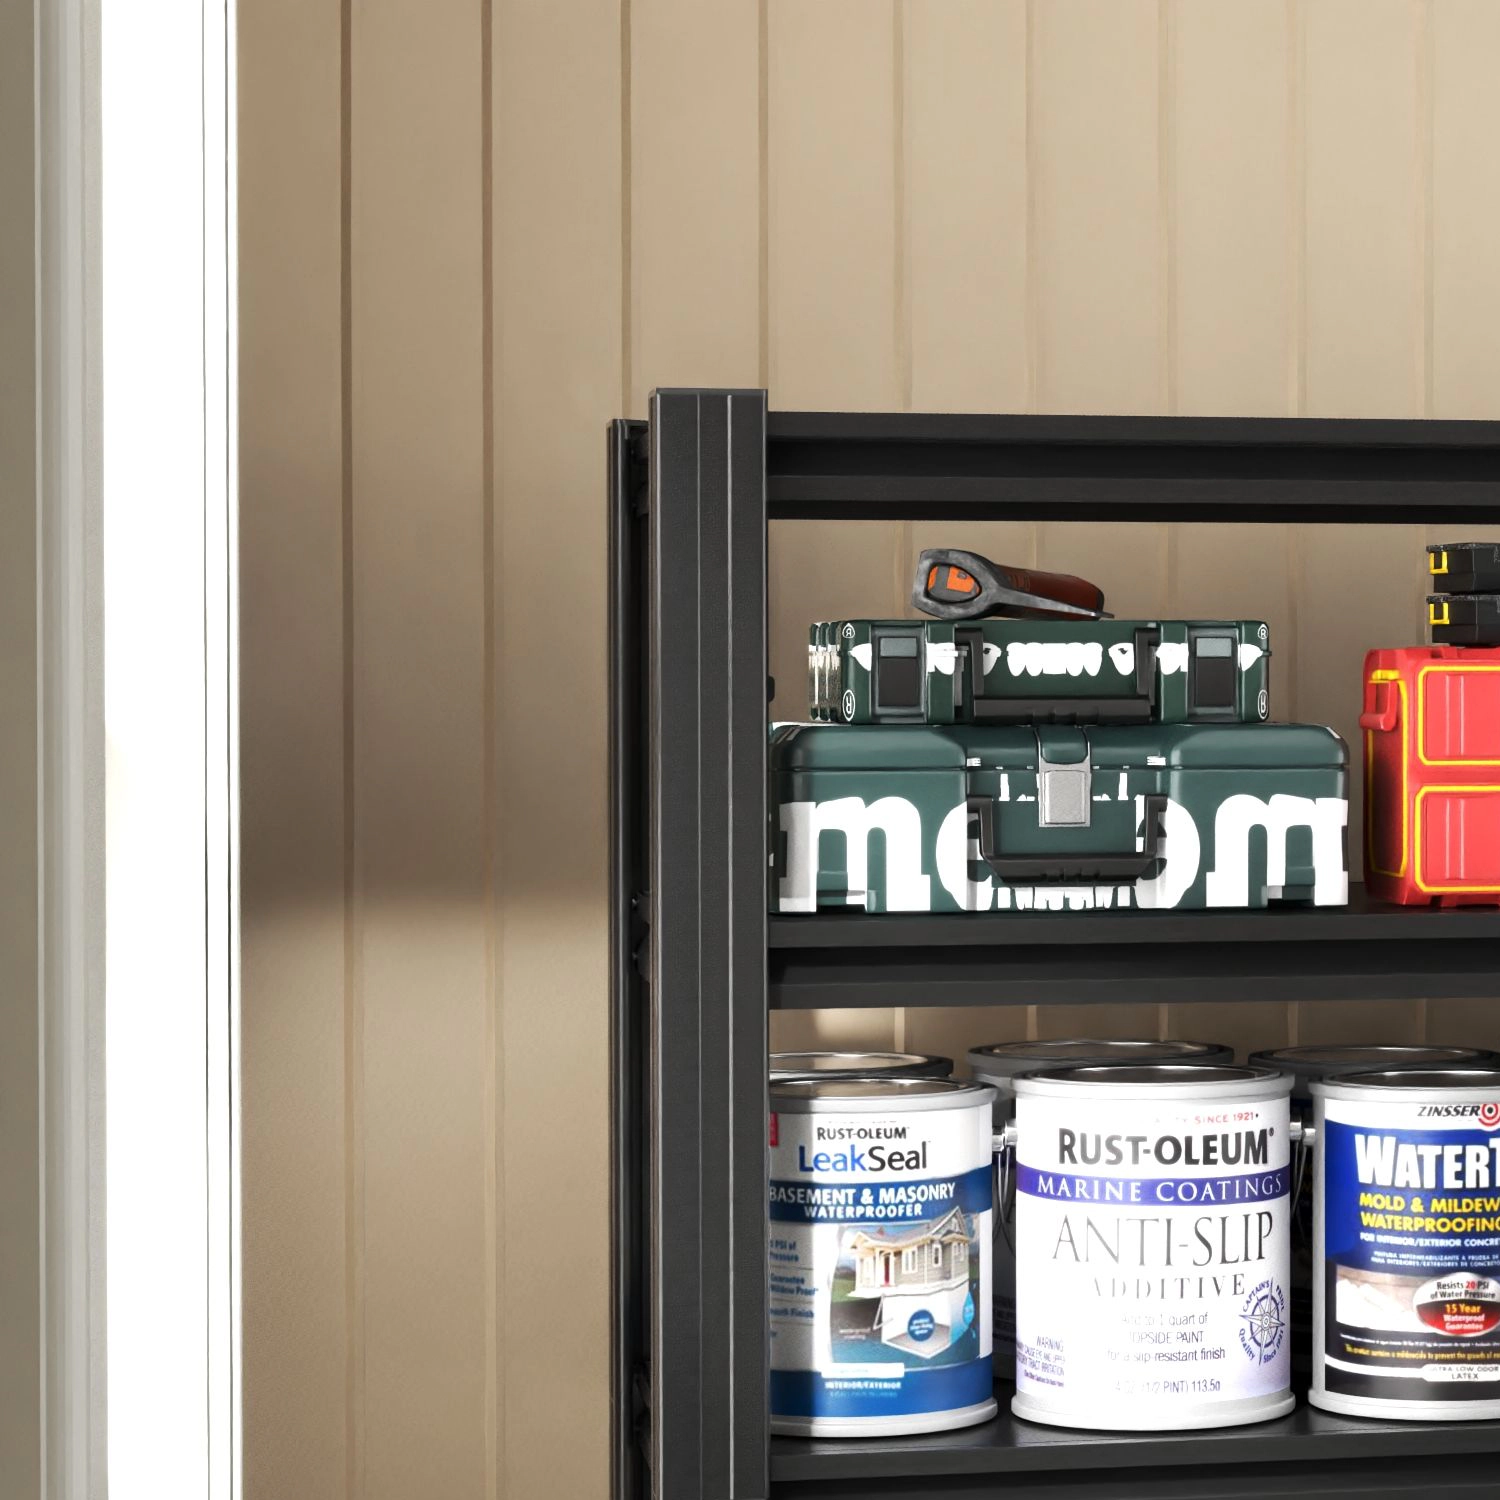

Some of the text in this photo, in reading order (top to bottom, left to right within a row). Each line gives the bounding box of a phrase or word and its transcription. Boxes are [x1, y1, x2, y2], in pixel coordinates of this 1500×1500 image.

[1417, 1104, 1481, 1118] ZINSSER
[817, 1126, 907, 1141] RUST-OLEUM
[1058, 1127, 1269, 1166] RUST-OLEUM
[798, 1141, 927, 1173] LeakSeal
[769, 1182, 956, 1206] BASEMENT & MASONRY
[1037, 1174, 1142, 1202] MARINE
[1155, 1172, 1282, 1202] COATINGS
[1358, 1192, 1406, 1212] MOLD
[1410, 1197, 1424, 1213] &
[804, 1203, 923, 1219] WATERPROOFER
[1052, 1210, 1274, 1267] ANTI-SLIP
[1360, 1232, 1374, 1243] FOR
[1436, 1280, 1464, 1290] Resists
[1465, 1280, 1476, 1290] 20
[1430, 1289, 1496, 1299] of Water Pressure
[1445, 1303, 1482, 1314] 15 Year
[1128, 1331, 1174, 1345] OPSIDE
[1451, 1372, 1479, 1380] LATEX
